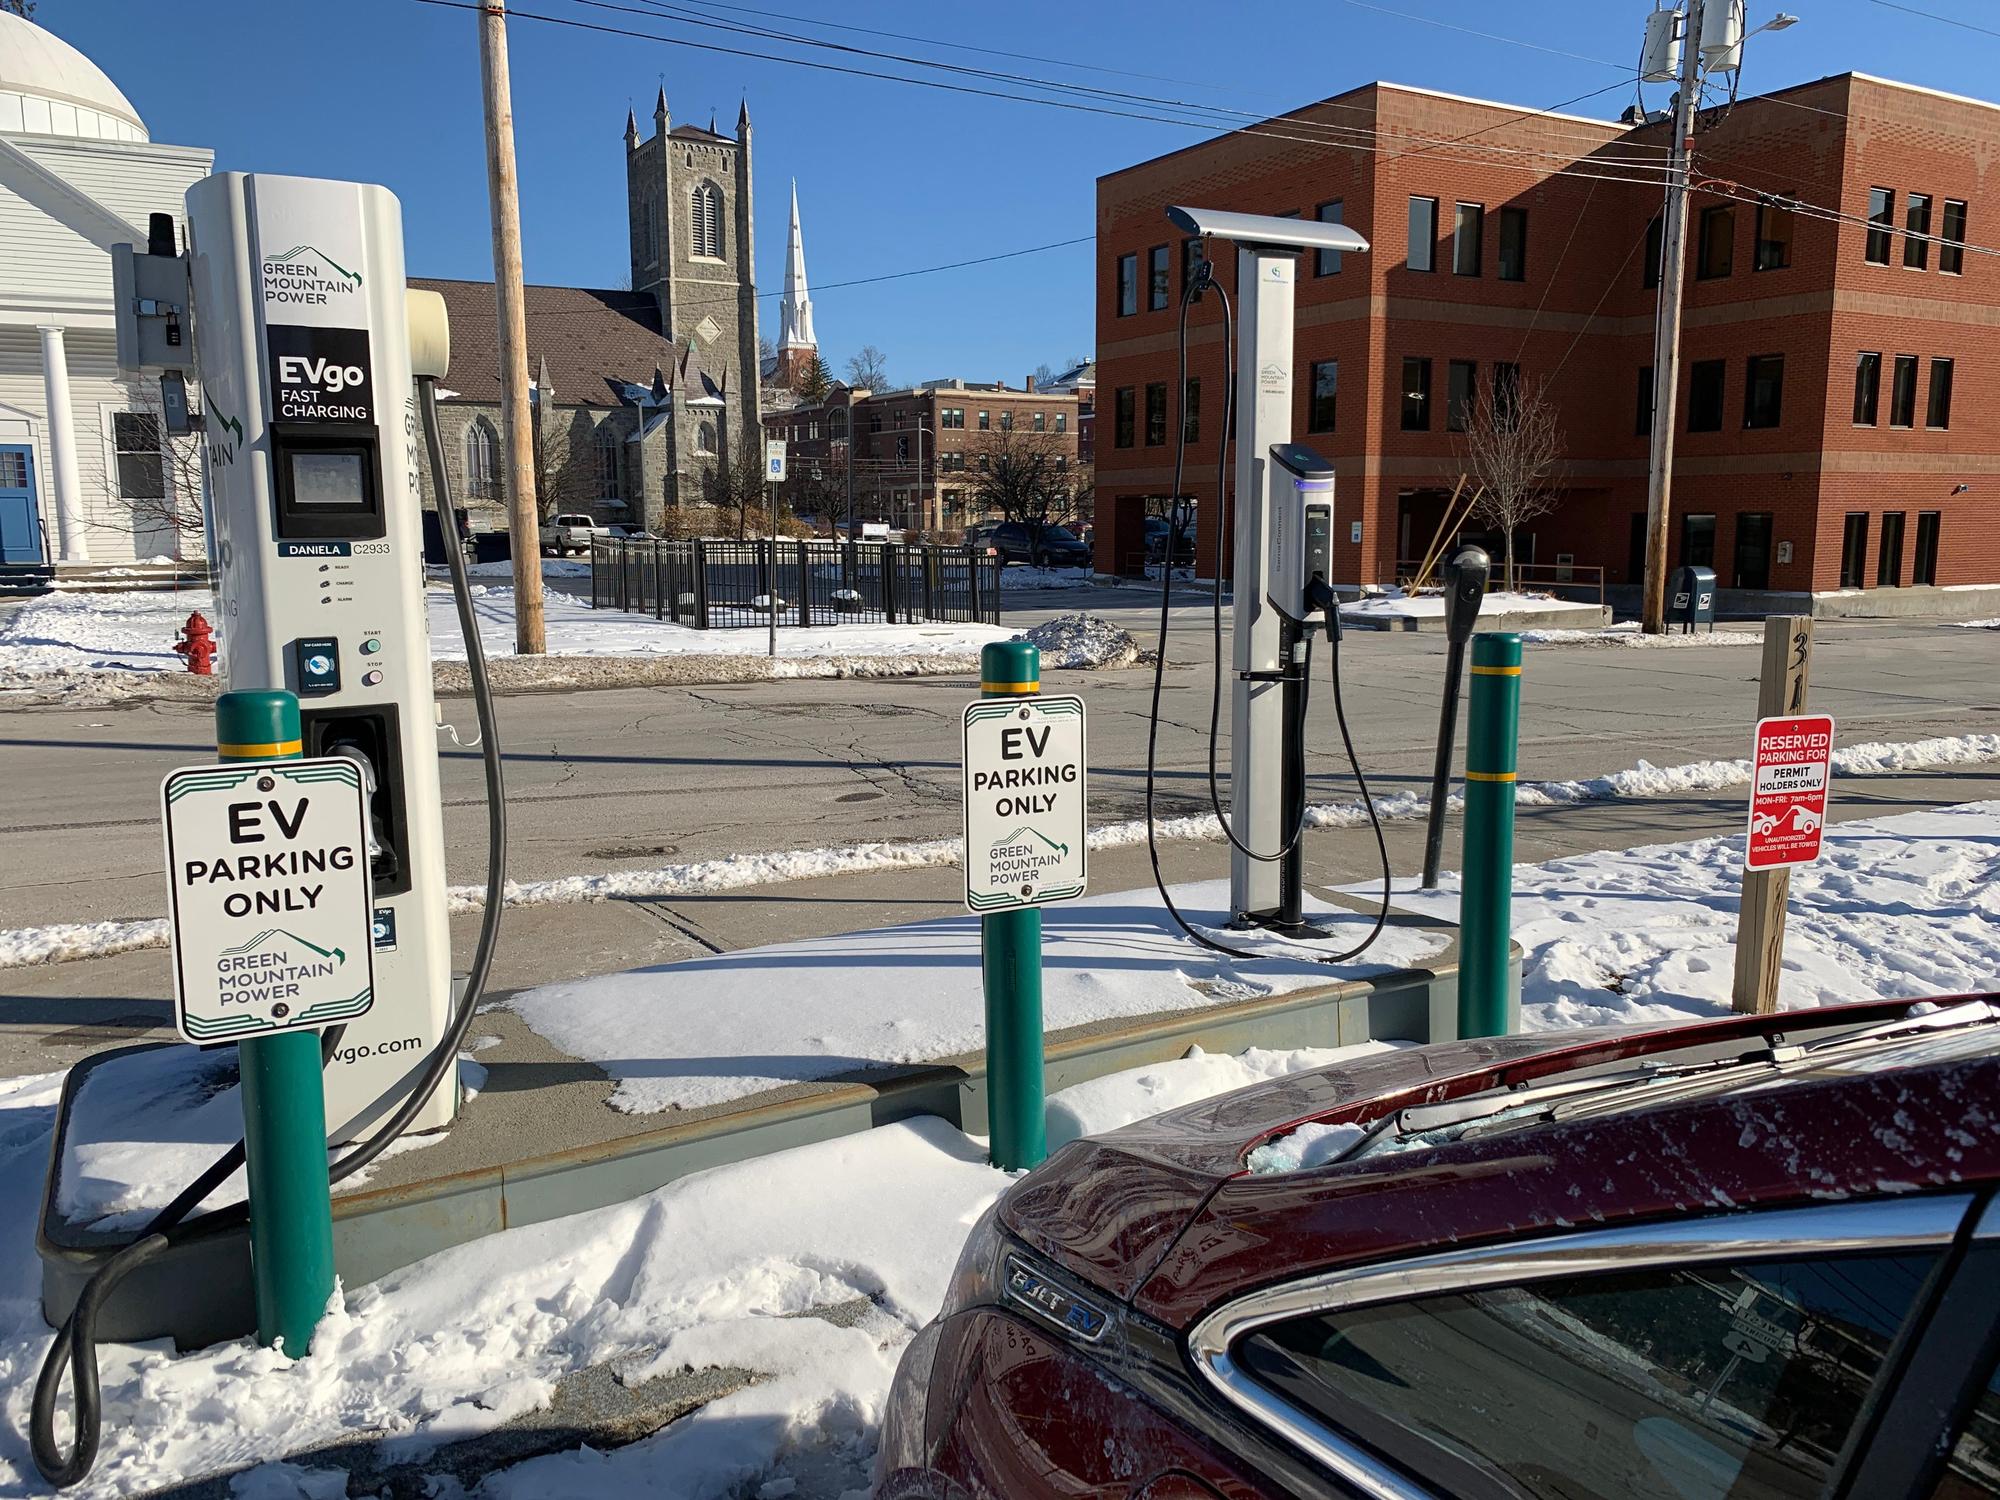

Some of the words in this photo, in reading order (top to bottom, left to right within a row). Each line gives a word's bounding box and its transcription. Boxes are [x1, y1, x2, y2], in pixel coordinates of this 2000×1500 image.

[263, 262, 317, 277] GREEN
[264, 278, 353, 294] MOUNTAIN
[265, 291, 327, 305] POWER
[279, 356, 364, 392] EVgo
[281, 390, 321, 402] FAST
[282, 404, 367, 419] CHARGING
[289, 545, 340, 555] DANIELA
[353, 544, 390, 555] C2933
[1001, 725, 1051, 760] EV
[1760, 733, 1828, 751] RESERVED
[1760, 750, 1804, 764] PARKING
[1806, 749, 1826, 760] FOR
[974, 764, 1076, 791] PARKING
[1774, 767, 1811, 779] PERMIT
[1760, 780, 1798, 791] HOLDERS
[1800, 778, 1822, 788] ONLY
[996, 793, 1057, 817] ONLY
[1790, 794, 1823, 803] 7am-6pm
[228, 797, 309, 844] EV
[1765, 834, 1806, 843] UNAUTHORIZED
[990, 844, 1033, 859] GREEN
[185, 846, 354, 885] PARKING
[990, 854, 1061, 873] MOUNTAIN
[990, 870, 1039, 886] POWER
[224, 884, 323, 917] ONLY
[217, 951, 287, 972] GREEN
[219, 962, 334, 990] MOUNTAIN
[220, 984, 299, 1006] POWER
[333, 1037, 422, 1064] vgo.com
[1012, 1270, 1065, 1310] BOLT
[1067, 1304, 1100, 1329] EV
